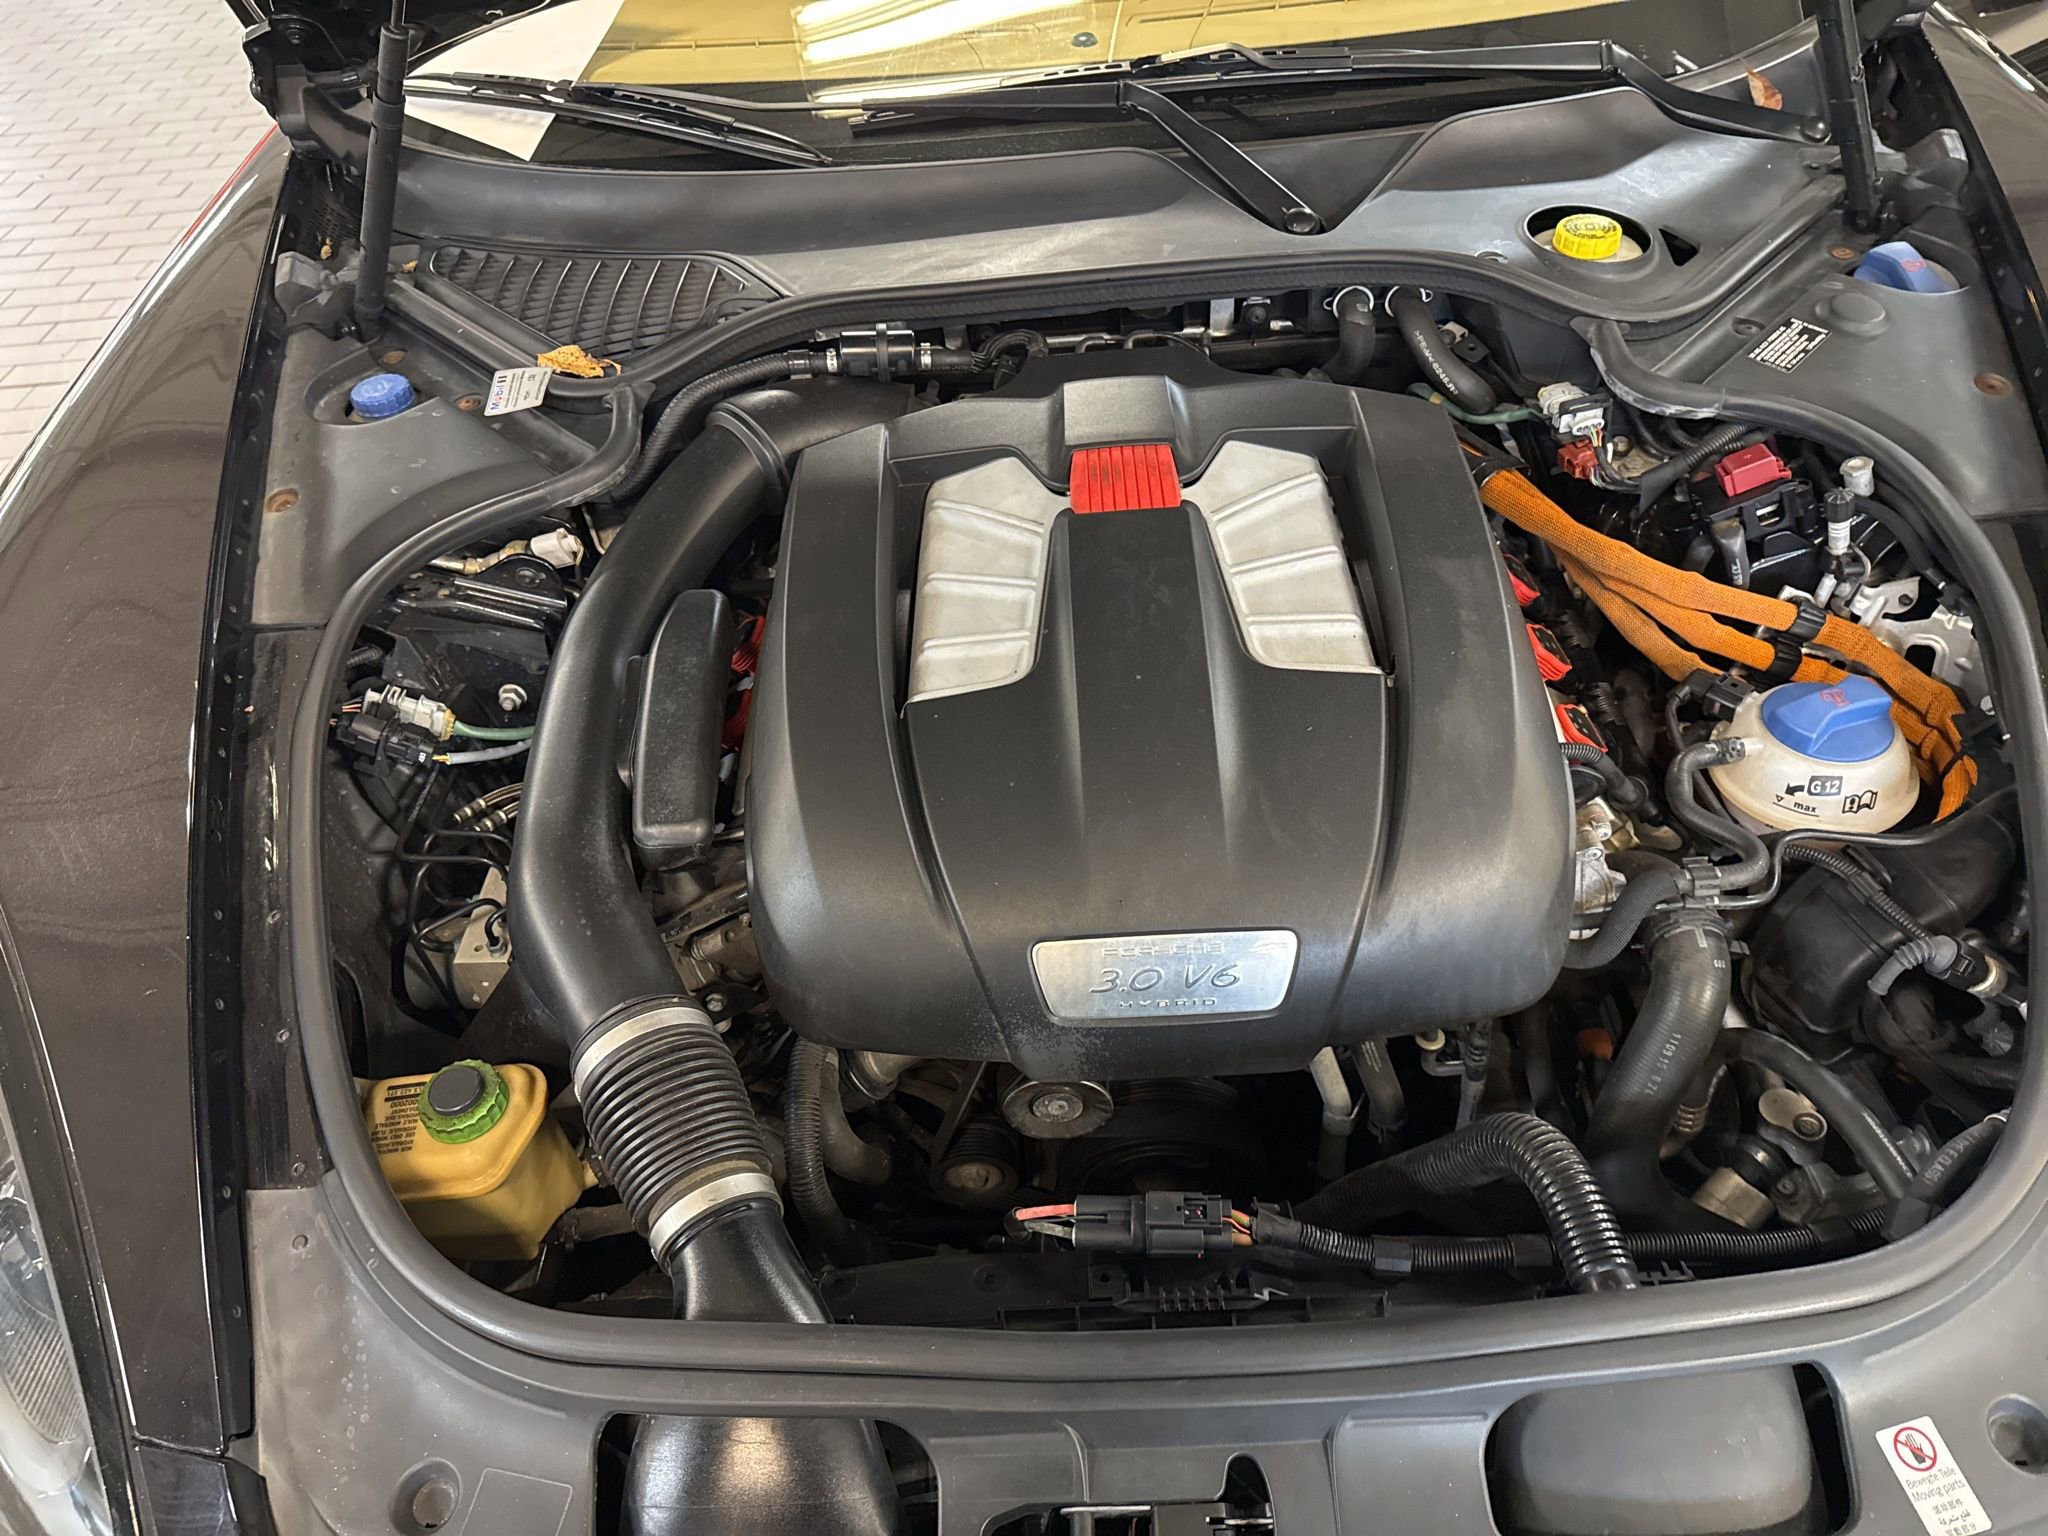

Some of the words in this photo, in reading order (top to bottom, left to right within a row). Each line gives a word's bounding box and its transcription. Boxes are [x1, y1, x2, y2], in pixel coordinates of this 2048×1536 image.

[1810, 781, 1821, 794] G
[1824, 779, 1841, 793] 12
[1793, 800, 1818, 814] max
[1088, 966, 1164, 994] 3.0
[1184, 961, 1241, 989] V6
[1119, 997, 1218, 1010] HYBRID
[1905, 1472, 1940, 1490] Bewegte
[1938, 1466, 1957, 1478] Teile
[1911, 1486, 1944, 1503] Moving
[1943, 1479, 1966, 1497] parts
